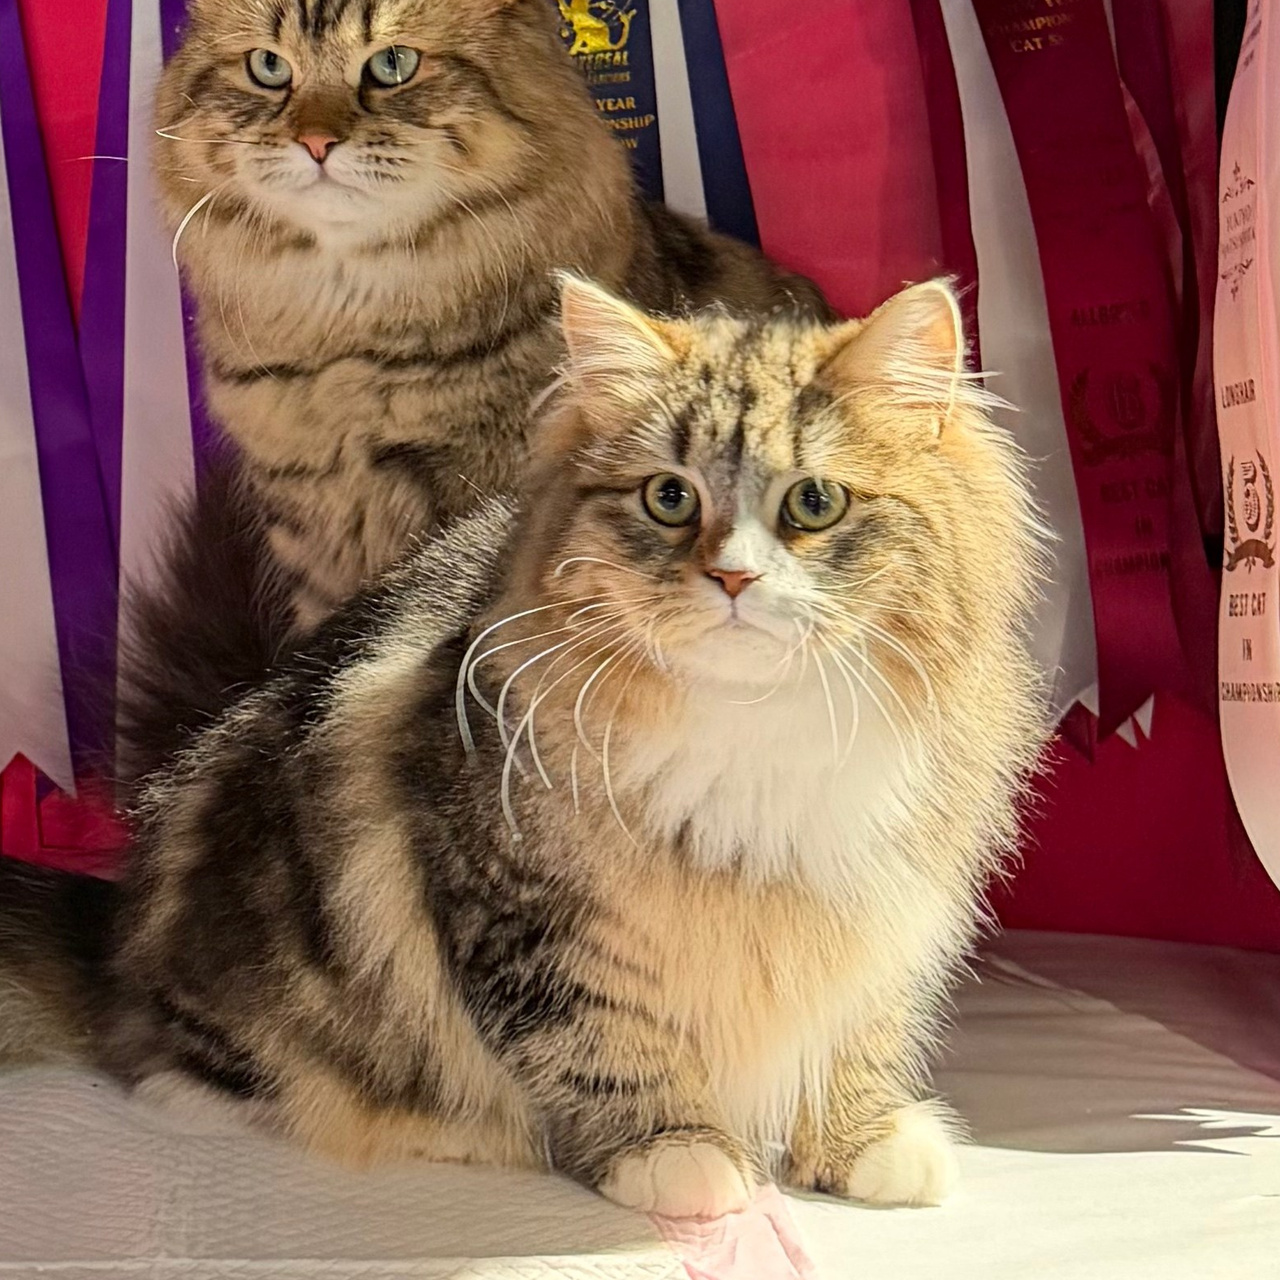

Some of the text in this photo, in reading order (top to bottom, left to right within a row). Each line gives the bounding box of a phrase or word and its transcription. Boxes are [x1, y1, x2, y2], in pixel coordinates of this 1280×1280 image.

[596, 96, 636, 112] YEAR
[1221, 378, 1257, 409] LONGHAIR
[1228, 592, 1266, 617] BEST CAT
[1242, 638, 1253, 661] IN
